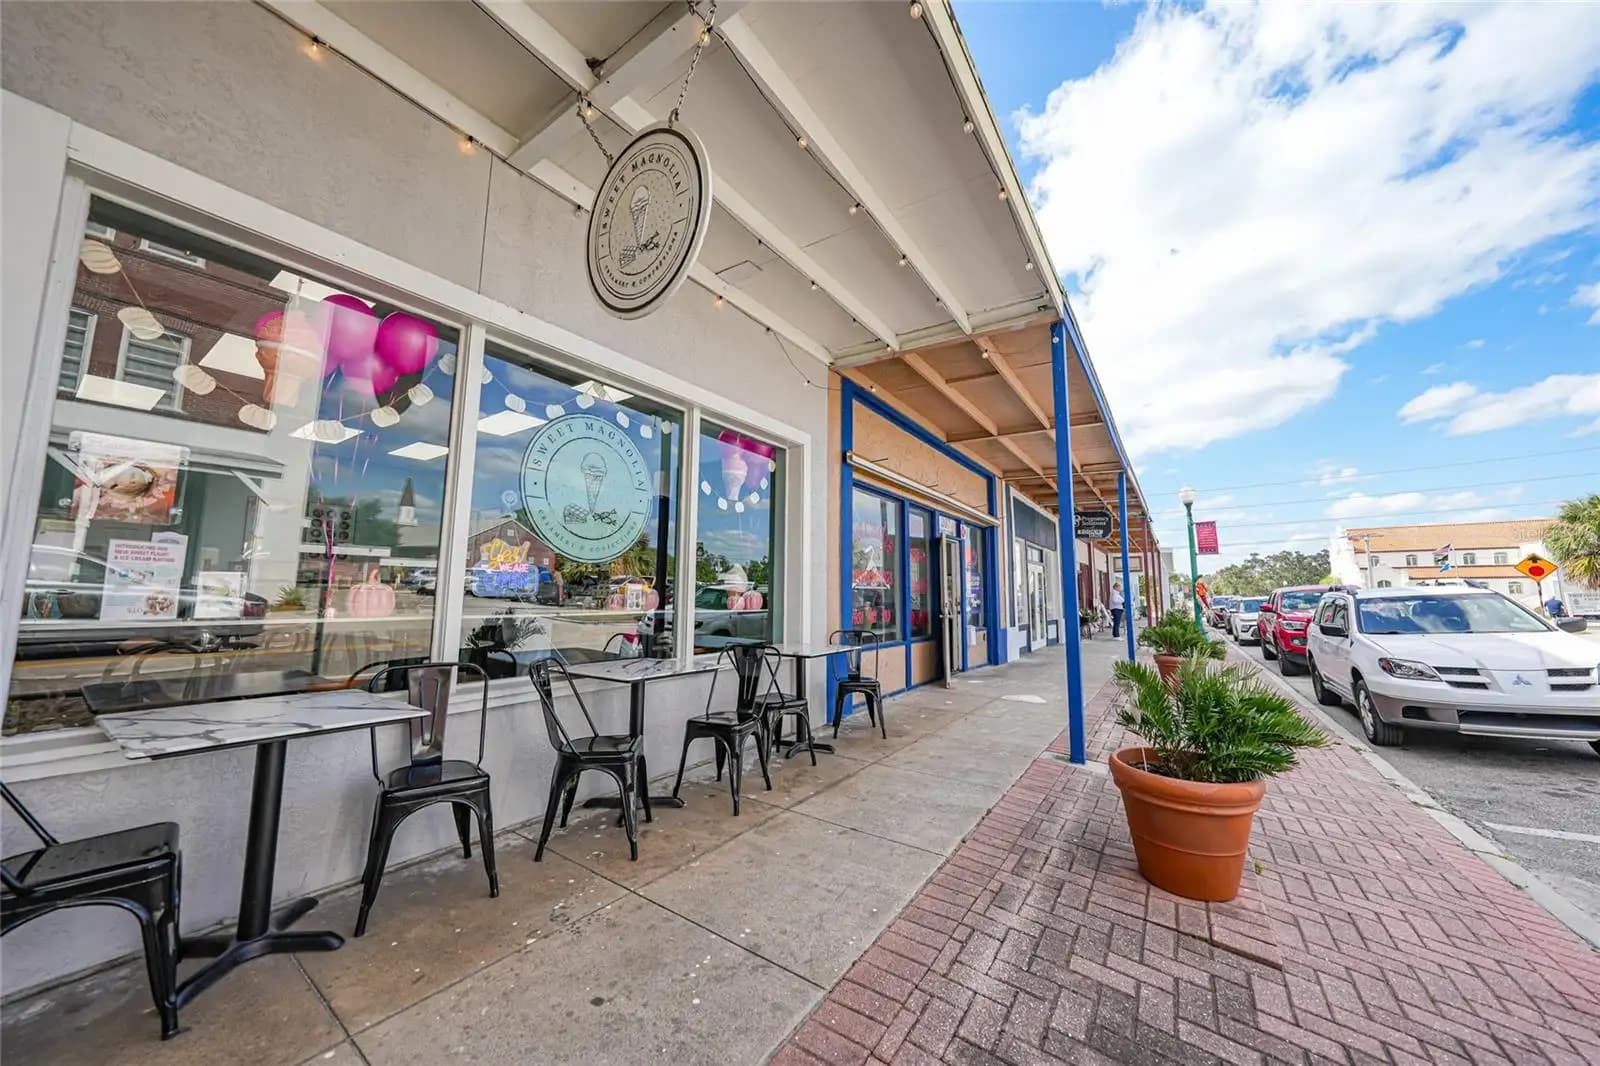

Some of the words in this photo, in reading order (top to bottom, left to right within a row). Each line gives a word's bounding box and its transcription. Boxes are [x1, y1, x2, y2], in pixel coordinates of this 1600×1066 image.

[602, 174, 626, 229] SWEET
[631, 152, 681, 190] MAGNOLIA
[533, 422, 575, 467] SWEET
[585, 421, 646, 487] MAGNOLIA
[480, 538, 530, 569] Yes!
